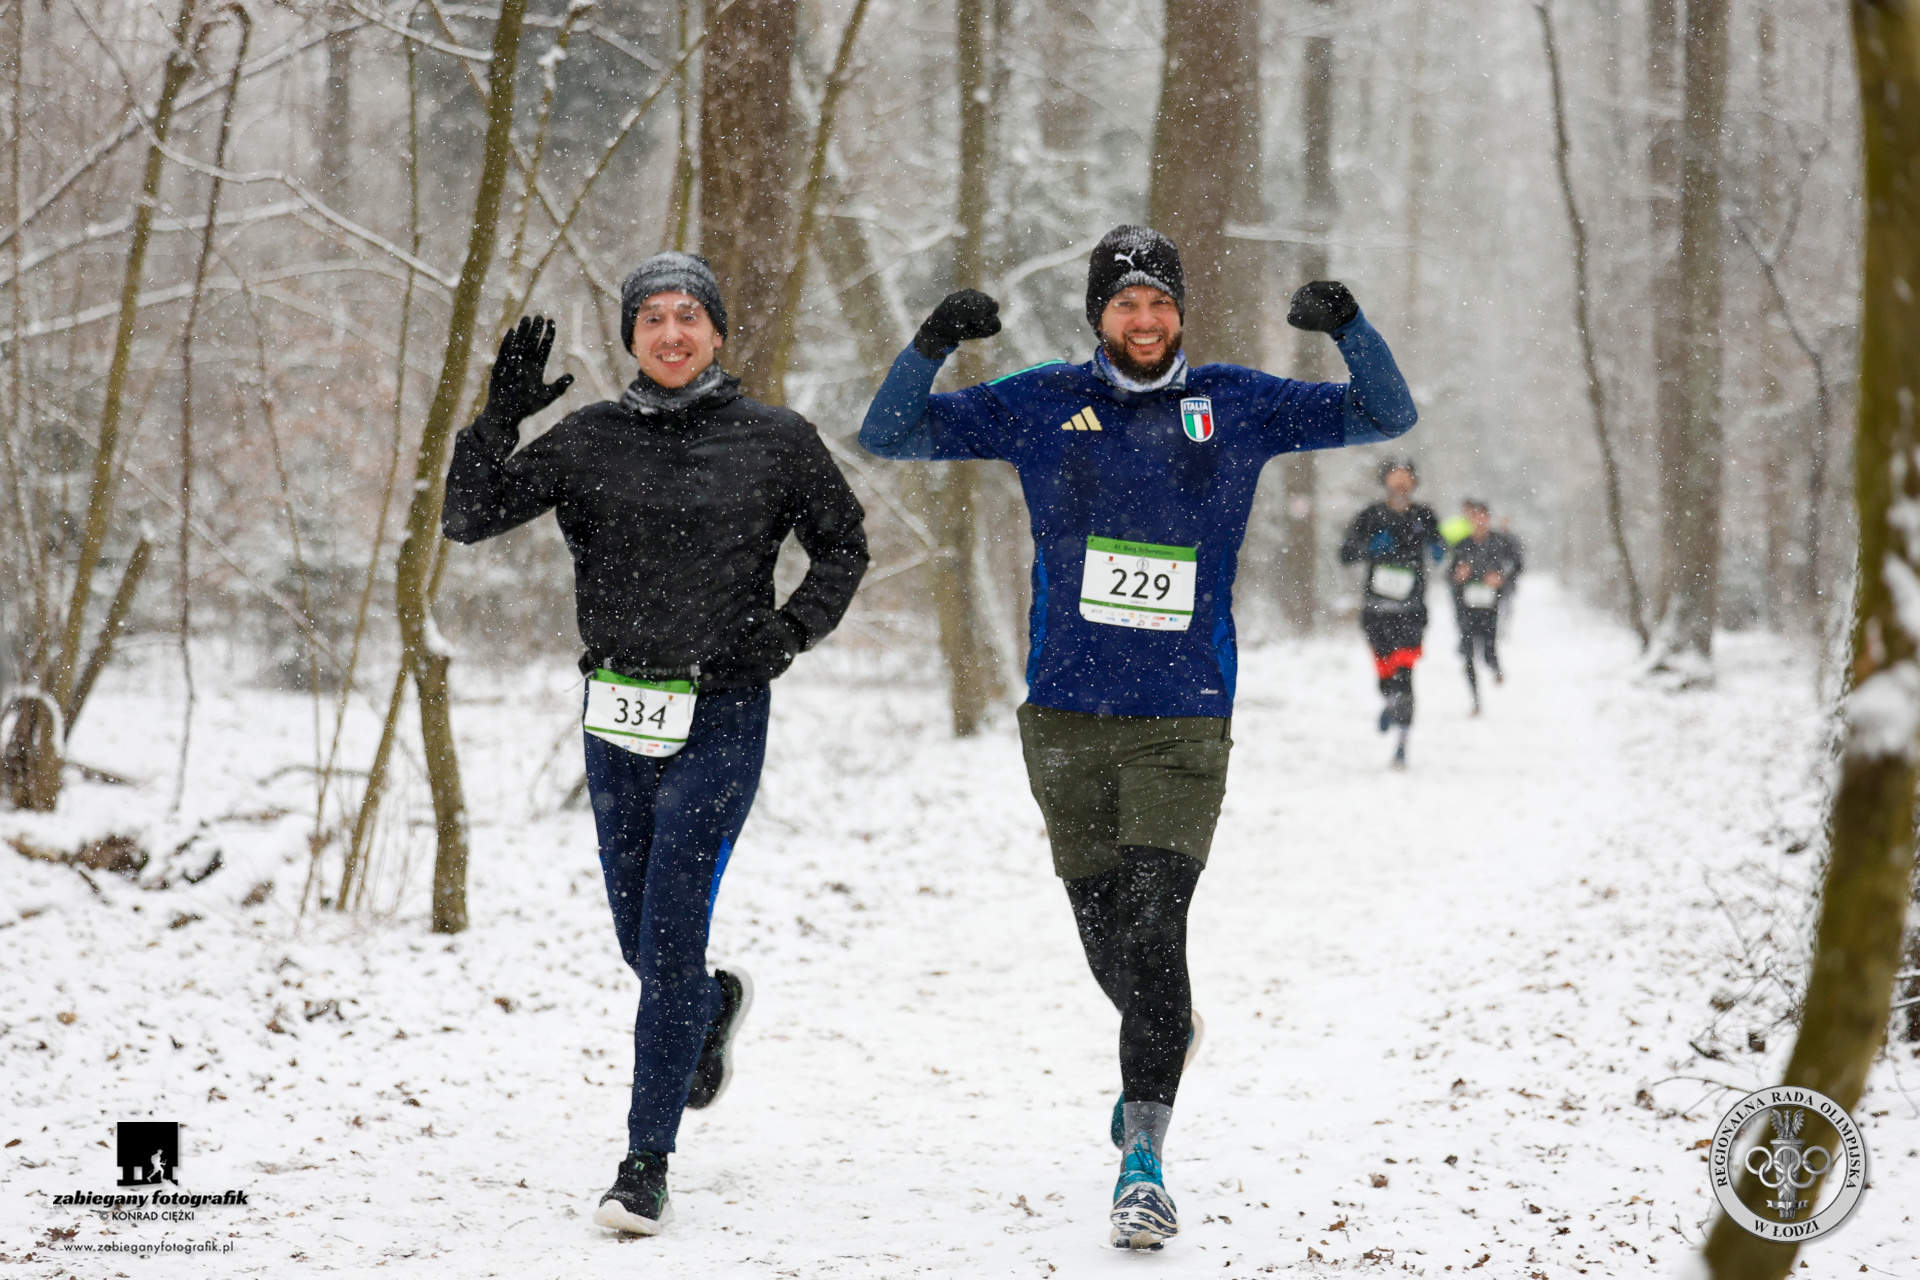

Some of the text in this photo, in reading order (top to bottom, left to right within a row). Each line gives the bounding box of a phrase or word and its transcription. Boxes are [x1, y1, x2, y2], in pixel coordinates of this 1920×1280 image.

[1183, 401, 1209, 411] ITALIA
[1109, 568, 1171, 601] 229
[614, 697, 667, 730] 334
